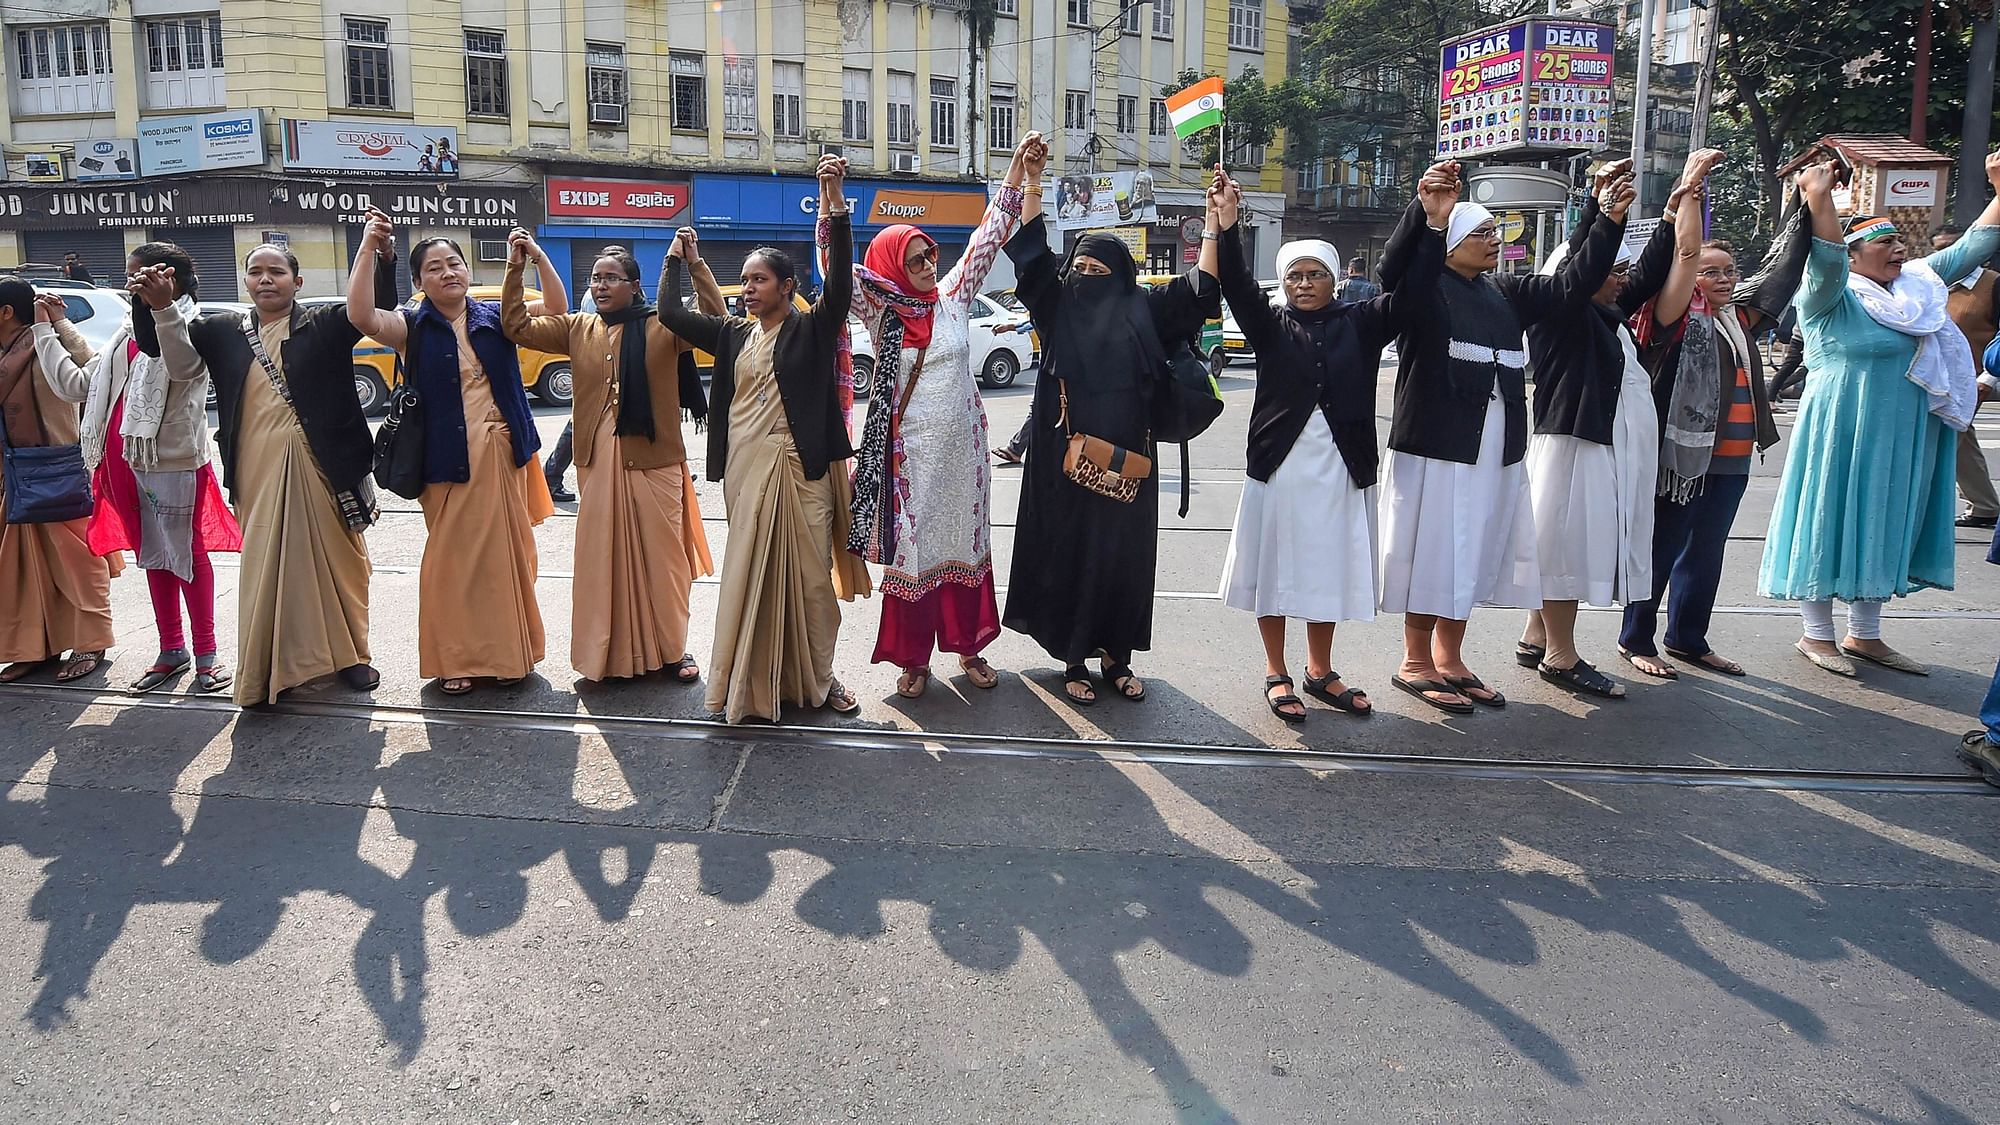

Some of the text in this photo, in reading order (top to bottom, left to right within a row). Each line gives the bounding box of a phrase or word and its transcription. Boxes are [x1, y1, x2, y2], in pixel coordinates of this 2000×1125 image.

[1546, 29, 1598, 47] DEAR
[1456, 34, 1510, 63] DEAR
[1539, 53, 1607, 80] 25 CRORES
[1450, 59, 1521, 96] 25 CRORES
[142, 125, 193, 137] WOOD JUNCTION
[337, 132, 405, 148] CRYSTAL
[1901, 180, 1930, 188] RUPA
[297, 192, 517, 214] WOOD JUNCTION
[559, 190, 609, 206] EXIDE
[625, 192, 675, 208] এক্সাইড
[878, 200, 926, 218] Shoppe
[98, 216, 168, 226] FURNITURE
[187, 213, 255, 224] INTERIORS
[445, 217, 518, 227] INTERIORS
[1156, 214, 1179, 227] Hotel
